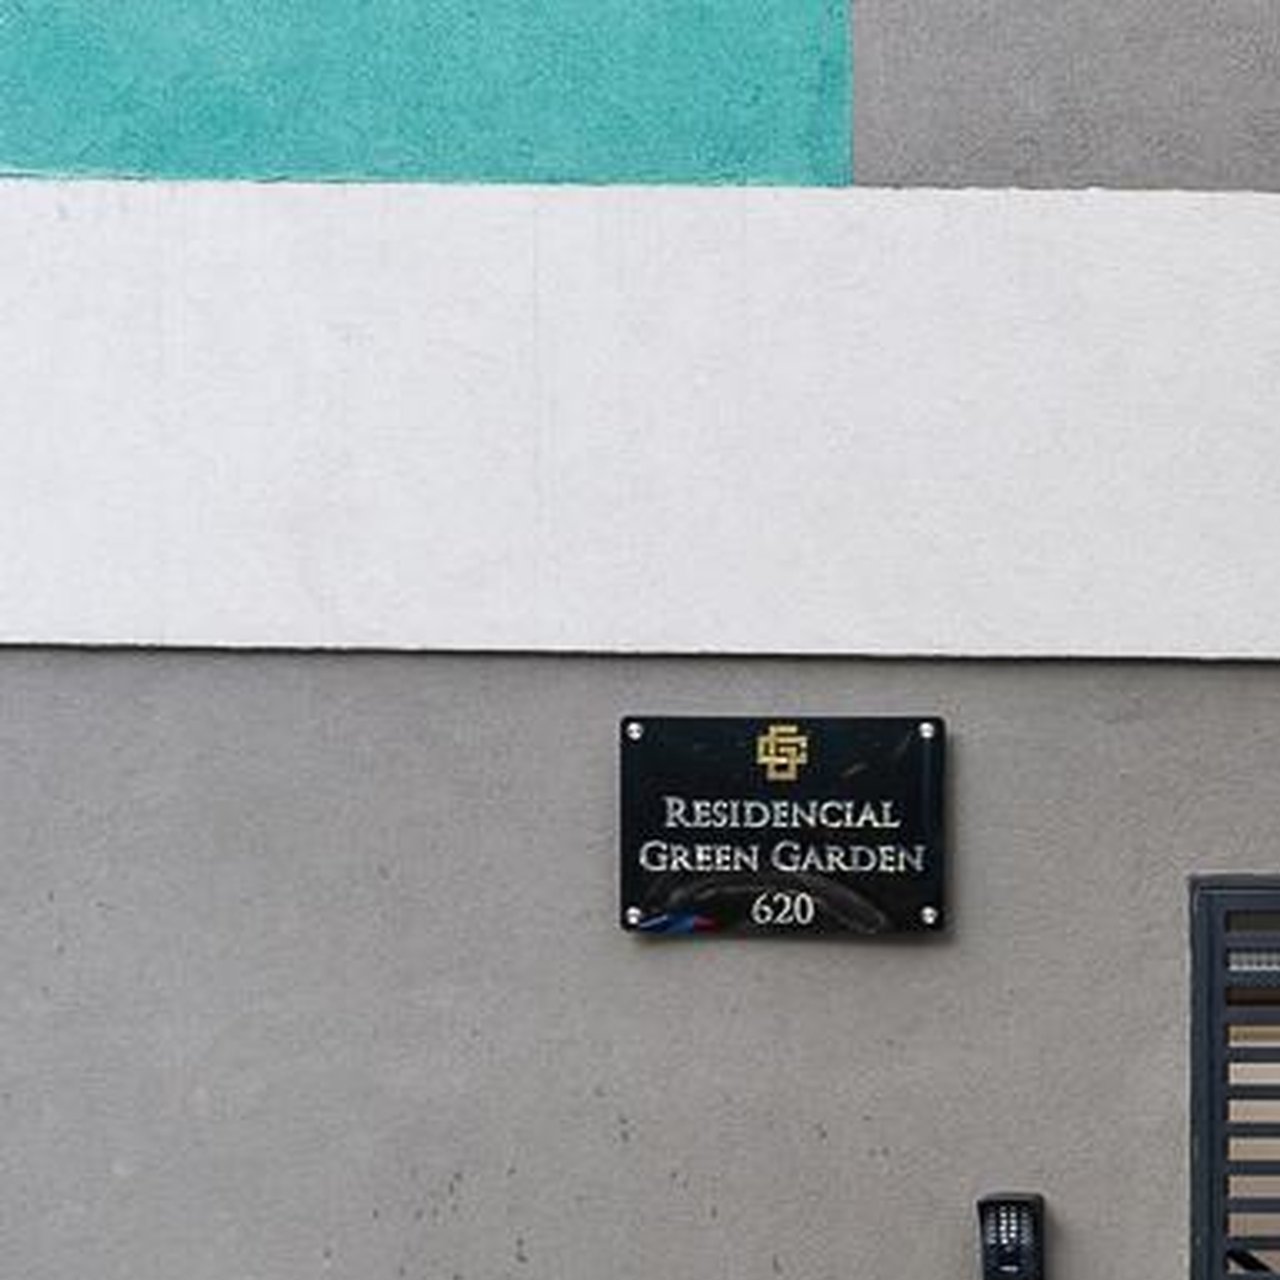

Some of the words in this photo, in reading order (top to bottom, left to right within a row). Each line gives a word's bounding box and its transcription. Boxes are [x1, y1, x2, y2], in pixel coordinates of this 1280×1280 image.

[664, 796, 901, 828] RESIDENCIAL
[639, 840, 759, 872] GREEN
[771, 840, 927, 872] GARDEN
[751, 892, 815, 925] 620
